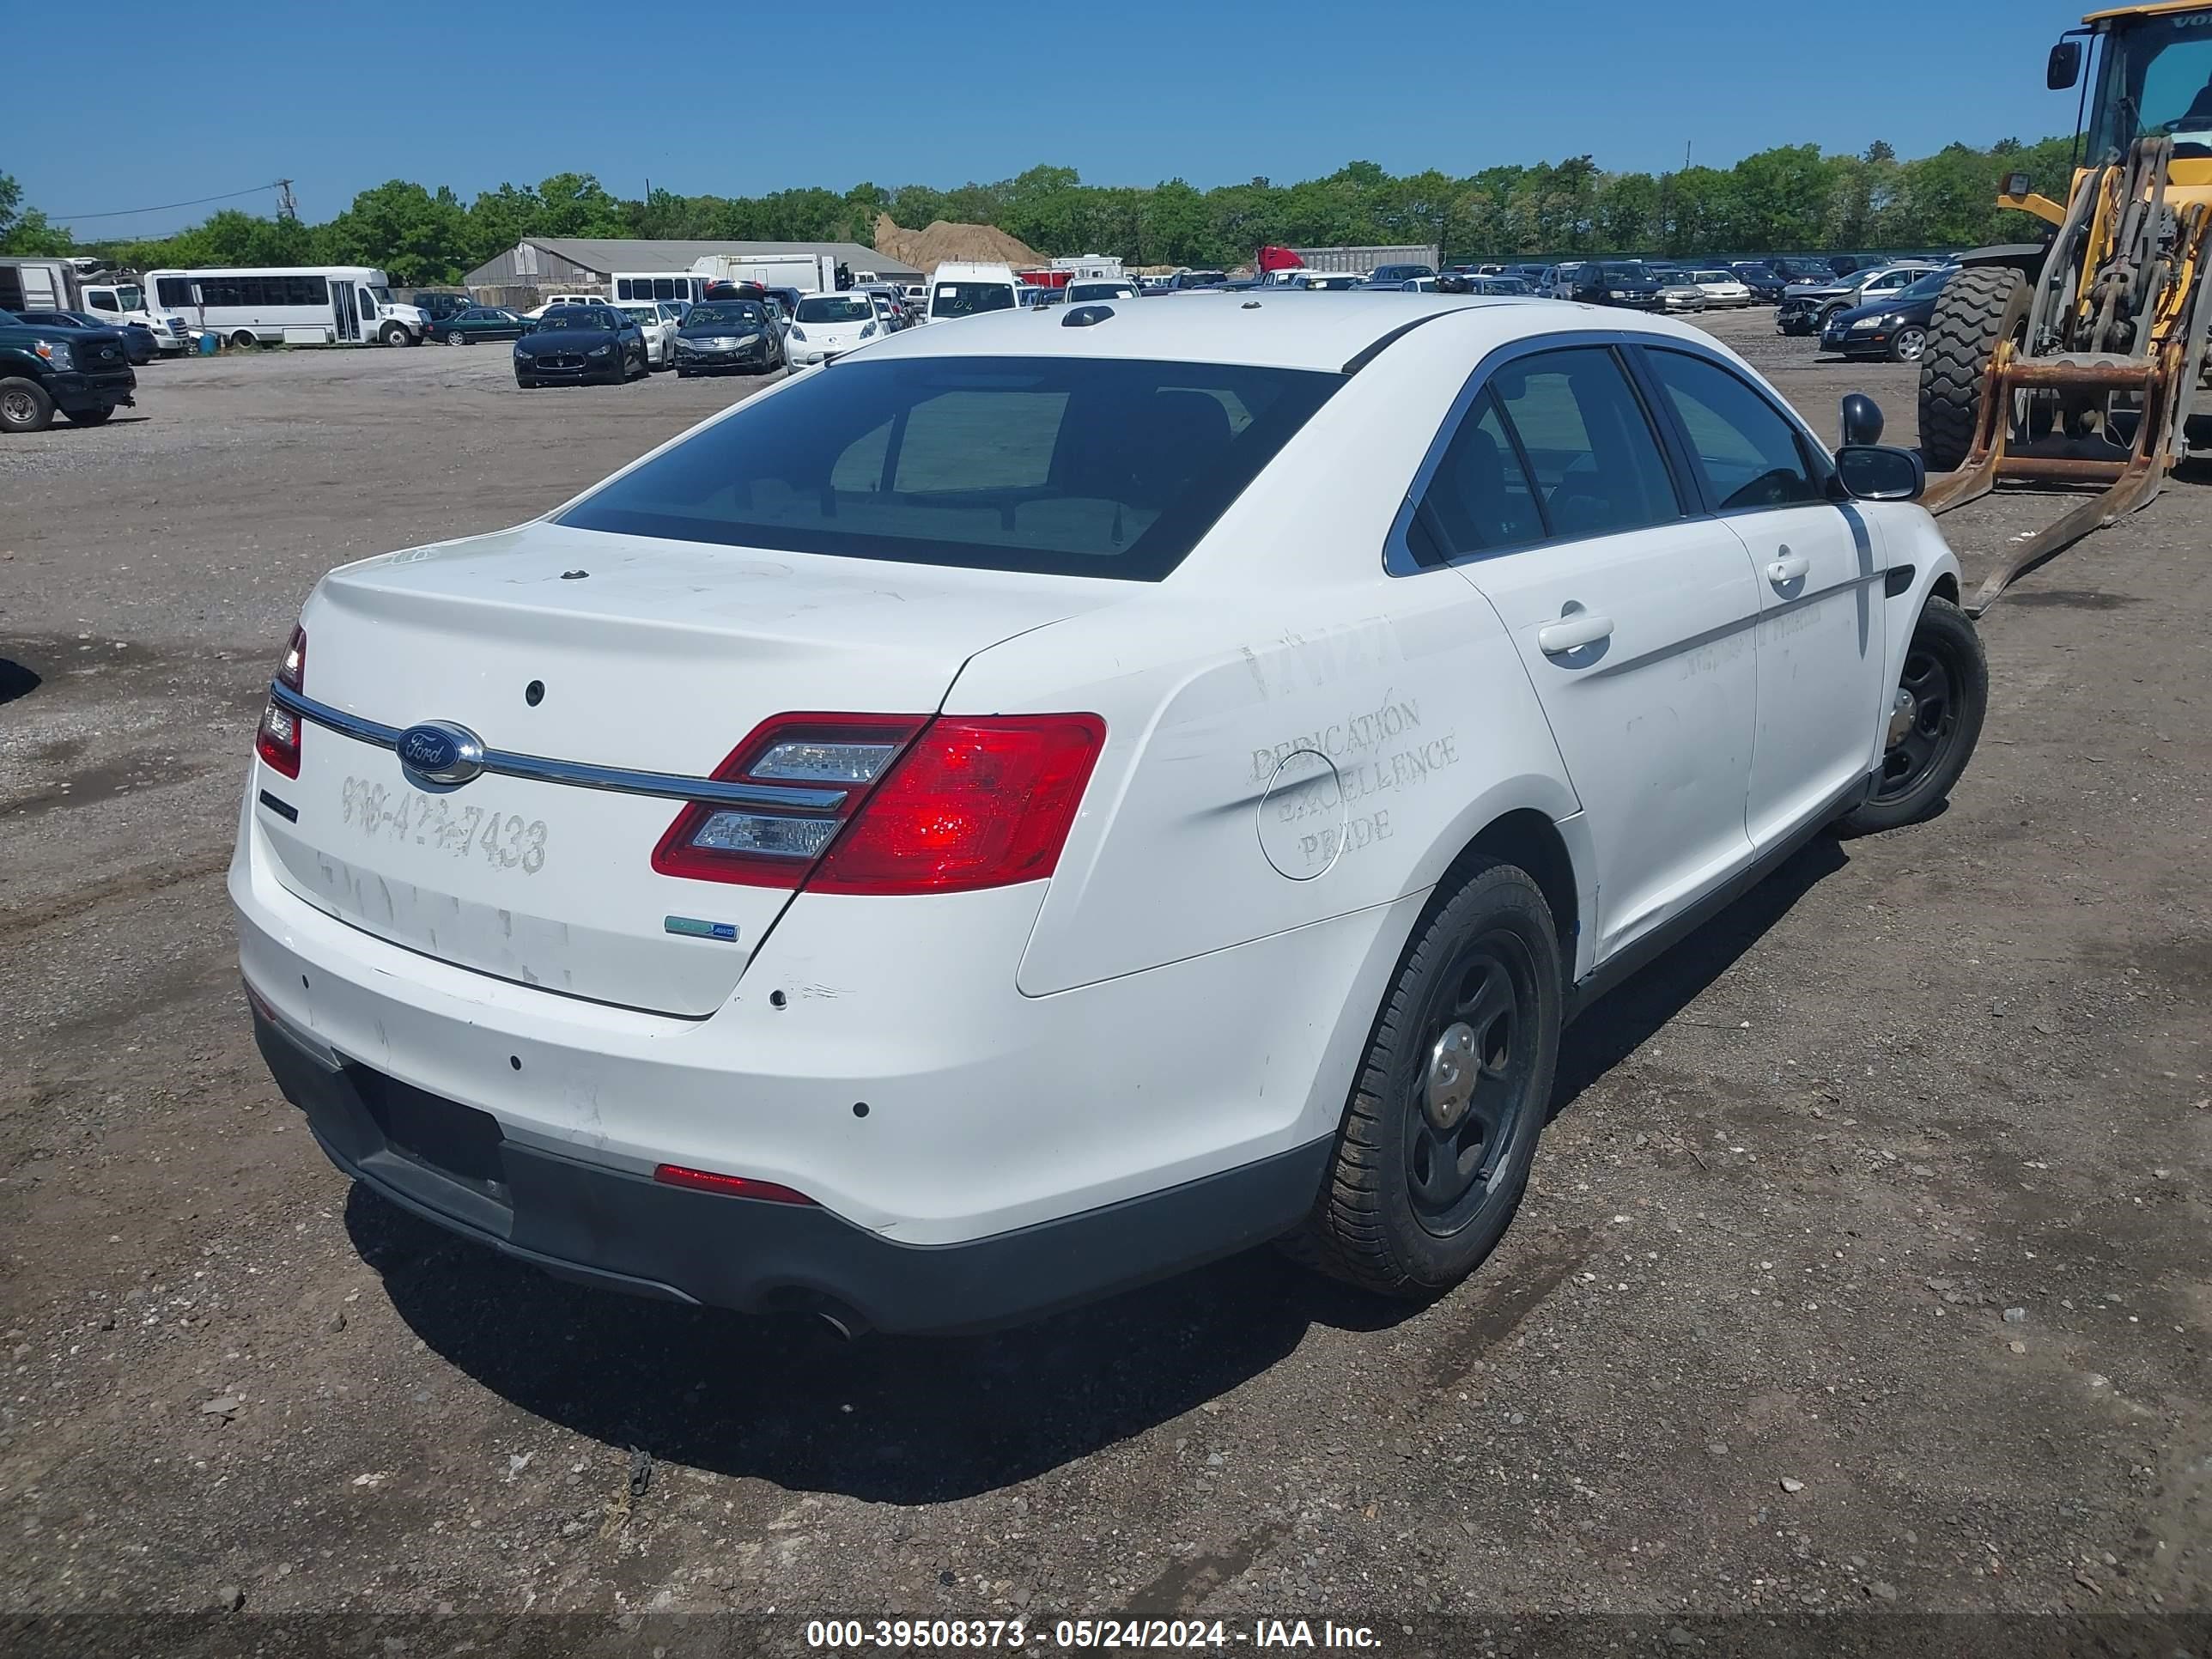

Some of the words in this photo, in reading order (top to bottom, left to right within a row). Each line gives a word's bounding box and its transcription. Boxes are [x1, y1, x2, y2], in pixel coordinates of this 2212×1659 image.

[405, 733, 445, 763] Ford
[1252, 700, 1420, 780] DEDICATION
[1279, 734, 1460, 822] EXCELLENCE
[1299, 810, 1394, 865] PRIDE
[714, 927, 734, 936] AWD
